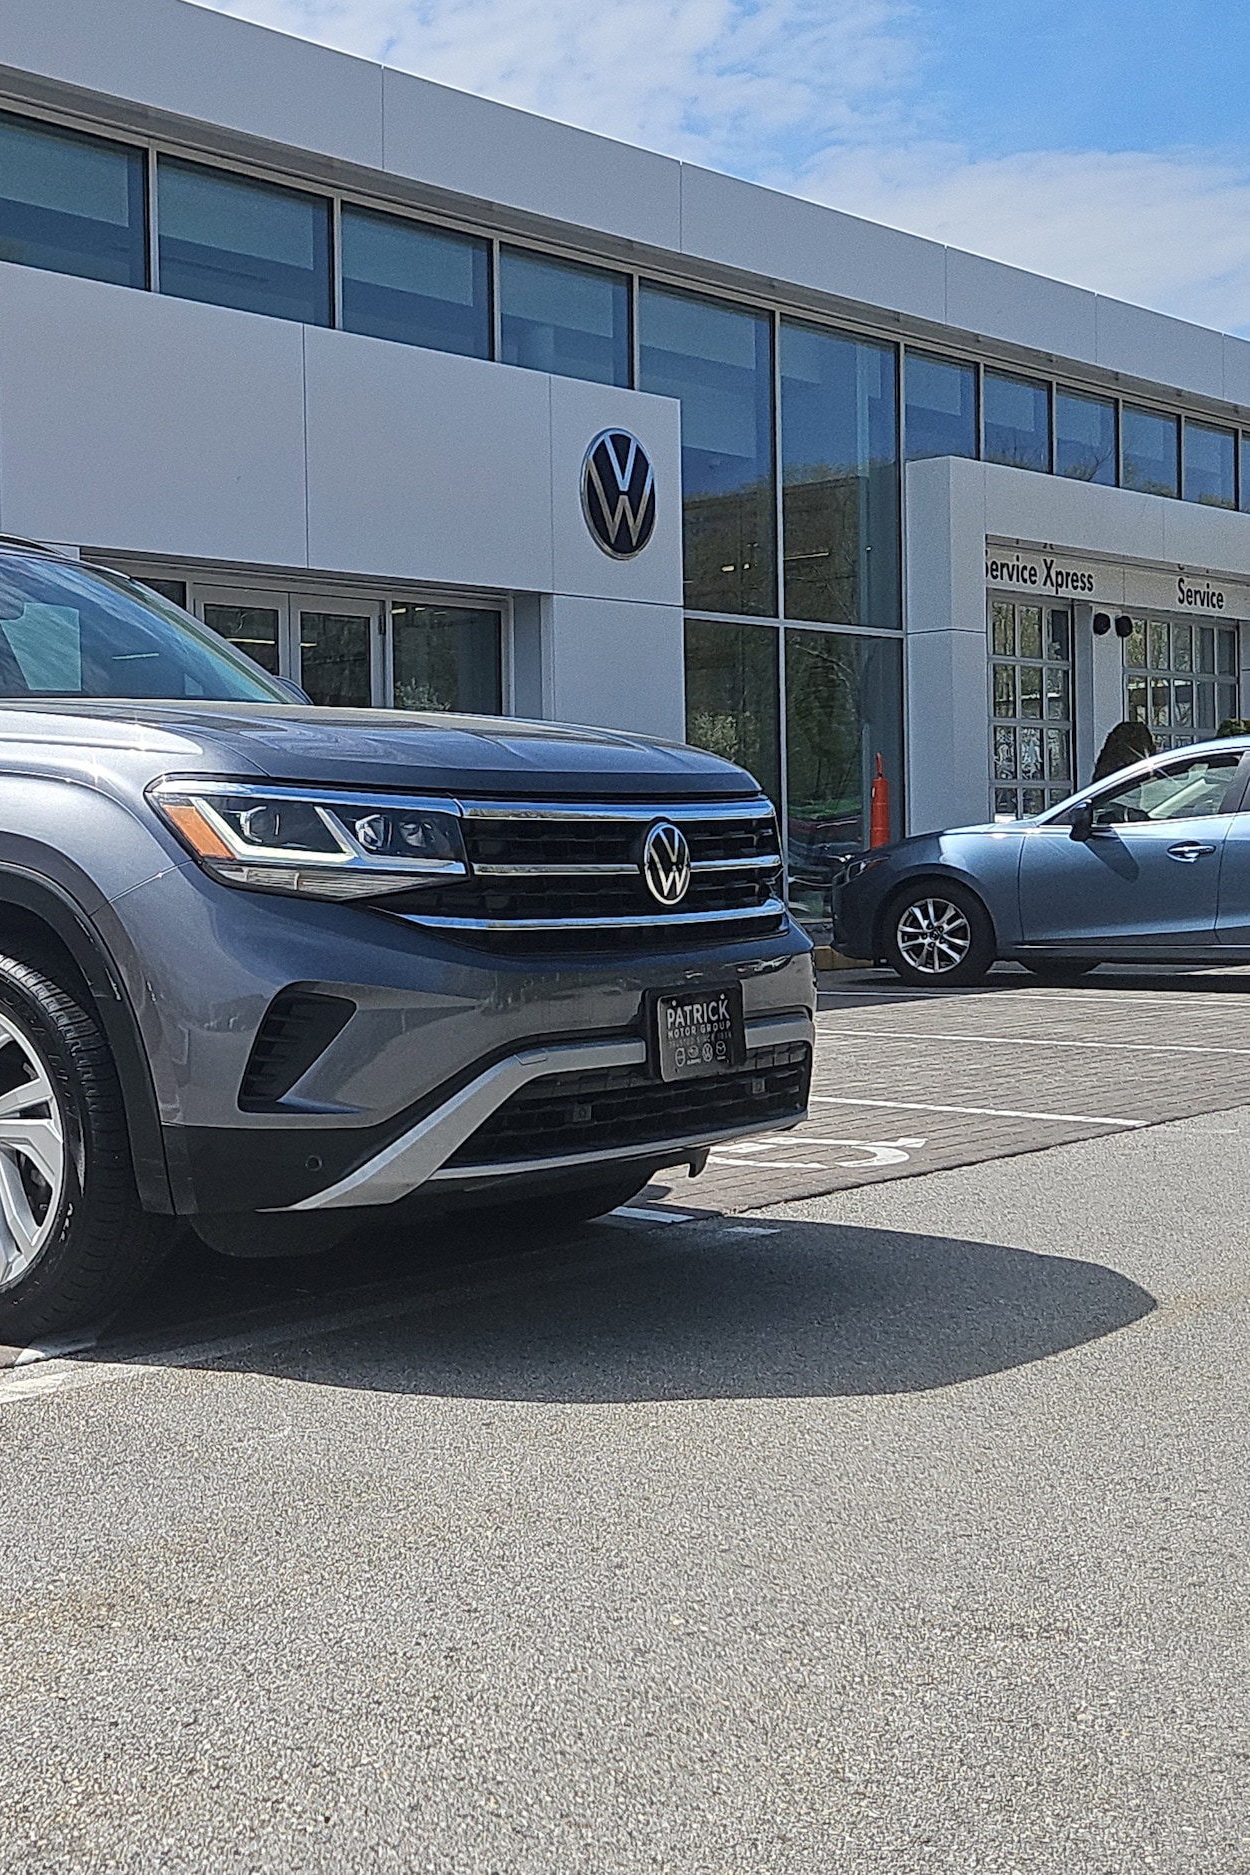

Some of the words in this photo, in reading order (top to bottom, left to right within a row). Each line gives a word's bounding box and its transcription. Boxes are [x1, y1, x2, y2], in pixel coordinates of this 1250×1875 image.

[1042, 558, 1094, 595] Xpress
[1177, 577, 1225, 610] Service
[667, 1000, 730, 1029] PATRICK
[667, 1025, 697, 1039] MOTOR
[700, 1020, 731, 1034] GROUP
